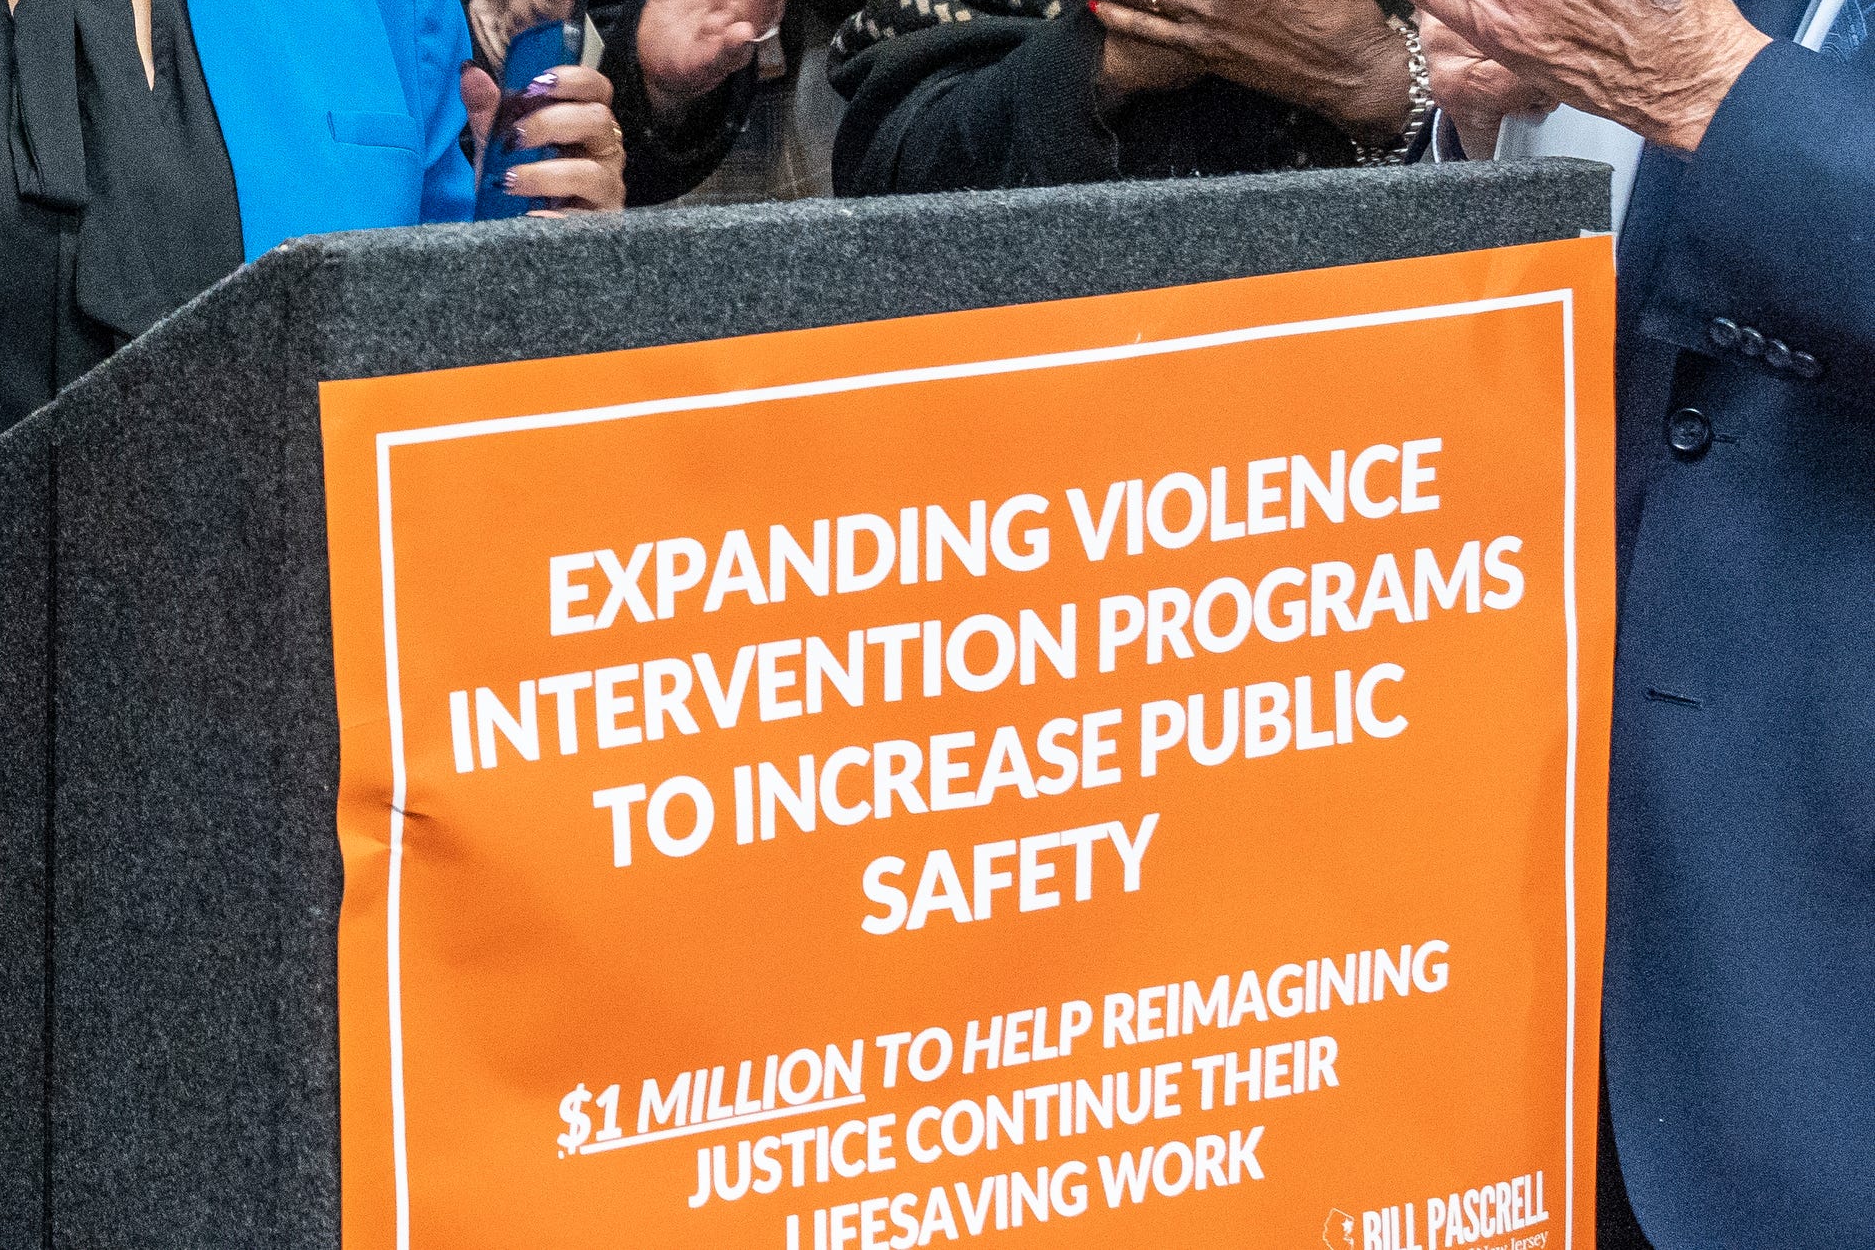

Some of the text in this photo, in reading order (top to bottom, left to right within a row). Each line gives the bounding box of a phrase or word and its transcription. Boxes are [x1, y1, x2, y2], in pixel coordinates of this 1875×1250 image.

[549, 437, 1443, 636] EXPANDING VIOLENCE
[449, 535, 1525, 774] INTERVENTION PROGRAMS
[592, 662, 1409, 868] TO INCREASE PUBLIC
[861, 812, 1161, 936] SAFETY
[556, 939, 1450, 1156] $1 MILLION TO HELP REIMAGINING
[687, 1035, 1340, 1209] JUSTICE CONTINUE THEIR
[786, 1125, 1265, 1250] LIFESAVING WORK
[1362, 1170, 1550, 1250] BILL PASCRELL
